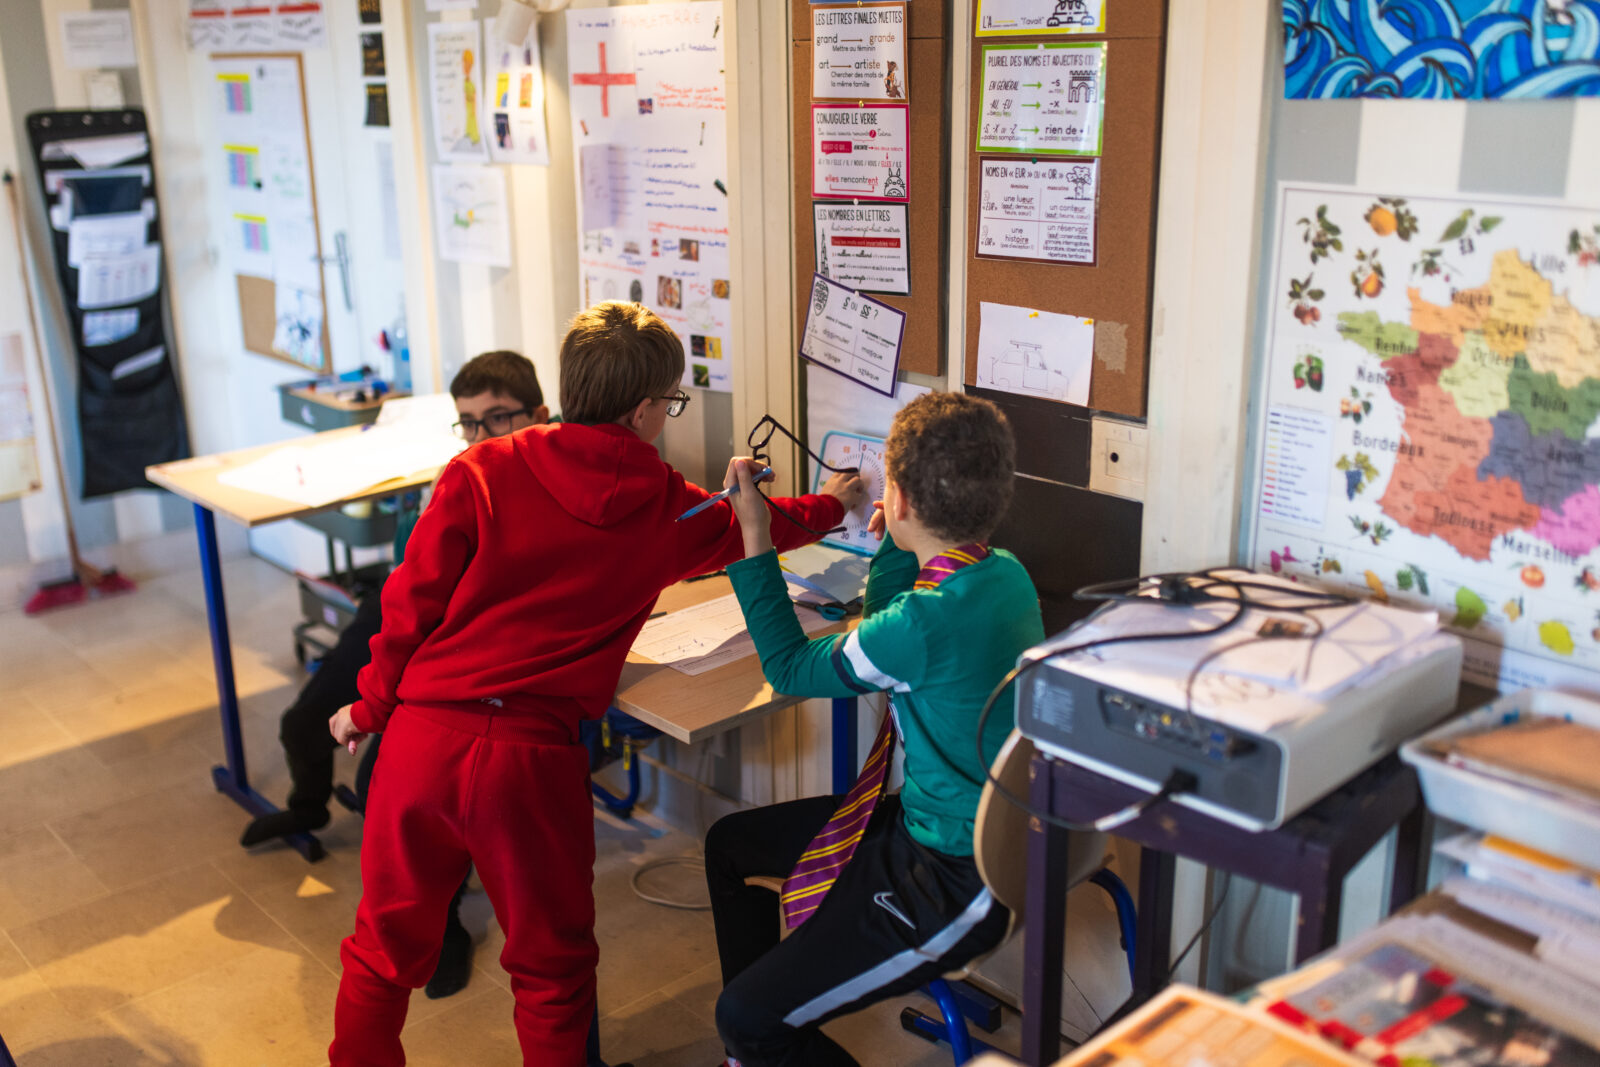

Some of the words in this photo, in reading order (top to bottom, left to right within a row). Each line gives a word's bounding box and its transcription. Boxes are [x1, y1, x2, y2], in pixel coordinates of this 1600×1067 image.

[815, 13, 826, 25] LES
[826, 12, 853, 25] LETTRES
[854, 11, 877, 24] FINALES
[878, 11, 903, 24] MUETTES
[816, 33, 838, 46] grand
[869, 32, 896, 45] grande
[857, 44, 876, 52] féminin
[818, 60, 830, 69] art
[854, 59, 881, 69] artiste
[988, 56, 1008, 67] PLURIEL
[1009, 55, 1022, 67] DES
[1023, 55, 1041, 67] NOMS
[1042, 55, 1051, 67] ET
[1052, 54, 1083, 67] ADJECTIFS
[853, 80, 870, 88] famille
[988, 80, 996, 91] EN
[816, 112, 850, 125] CONJUGUER
[851, 113, 858, 124] LE
[859, 112, 878, 125] VERBE
[1045, 123, 1062, 135] rien
[1065, 124, 1077, 135] de
[985, 166, 999, 178] NOMS
[1000, 166, 1008, 178] EN
[1014, 167, 1026, 178] EUR
[824, 173, 840, 183] elles
[840, 175, 879, 186] rencontrent
[1003, 195, 1015, 203] une
[1016, 194, 1035, 204] lueur
[817, 209, 827, 221] LES
[827, 209, 855, 221] NOMBRES
[855, 209, 864, 221] EN
[864, 209, 891, 222] LETTRES
[1005, 234, 1029, 244] histoire
[1531, 252, 1566, 273] Lille
[873, 309, 879, 320] ?
[1352, 430, 1425, 462] Bordeaux
[840, 532, 850, 540] 30
[1502, 535, 1580, 566] Marseille
